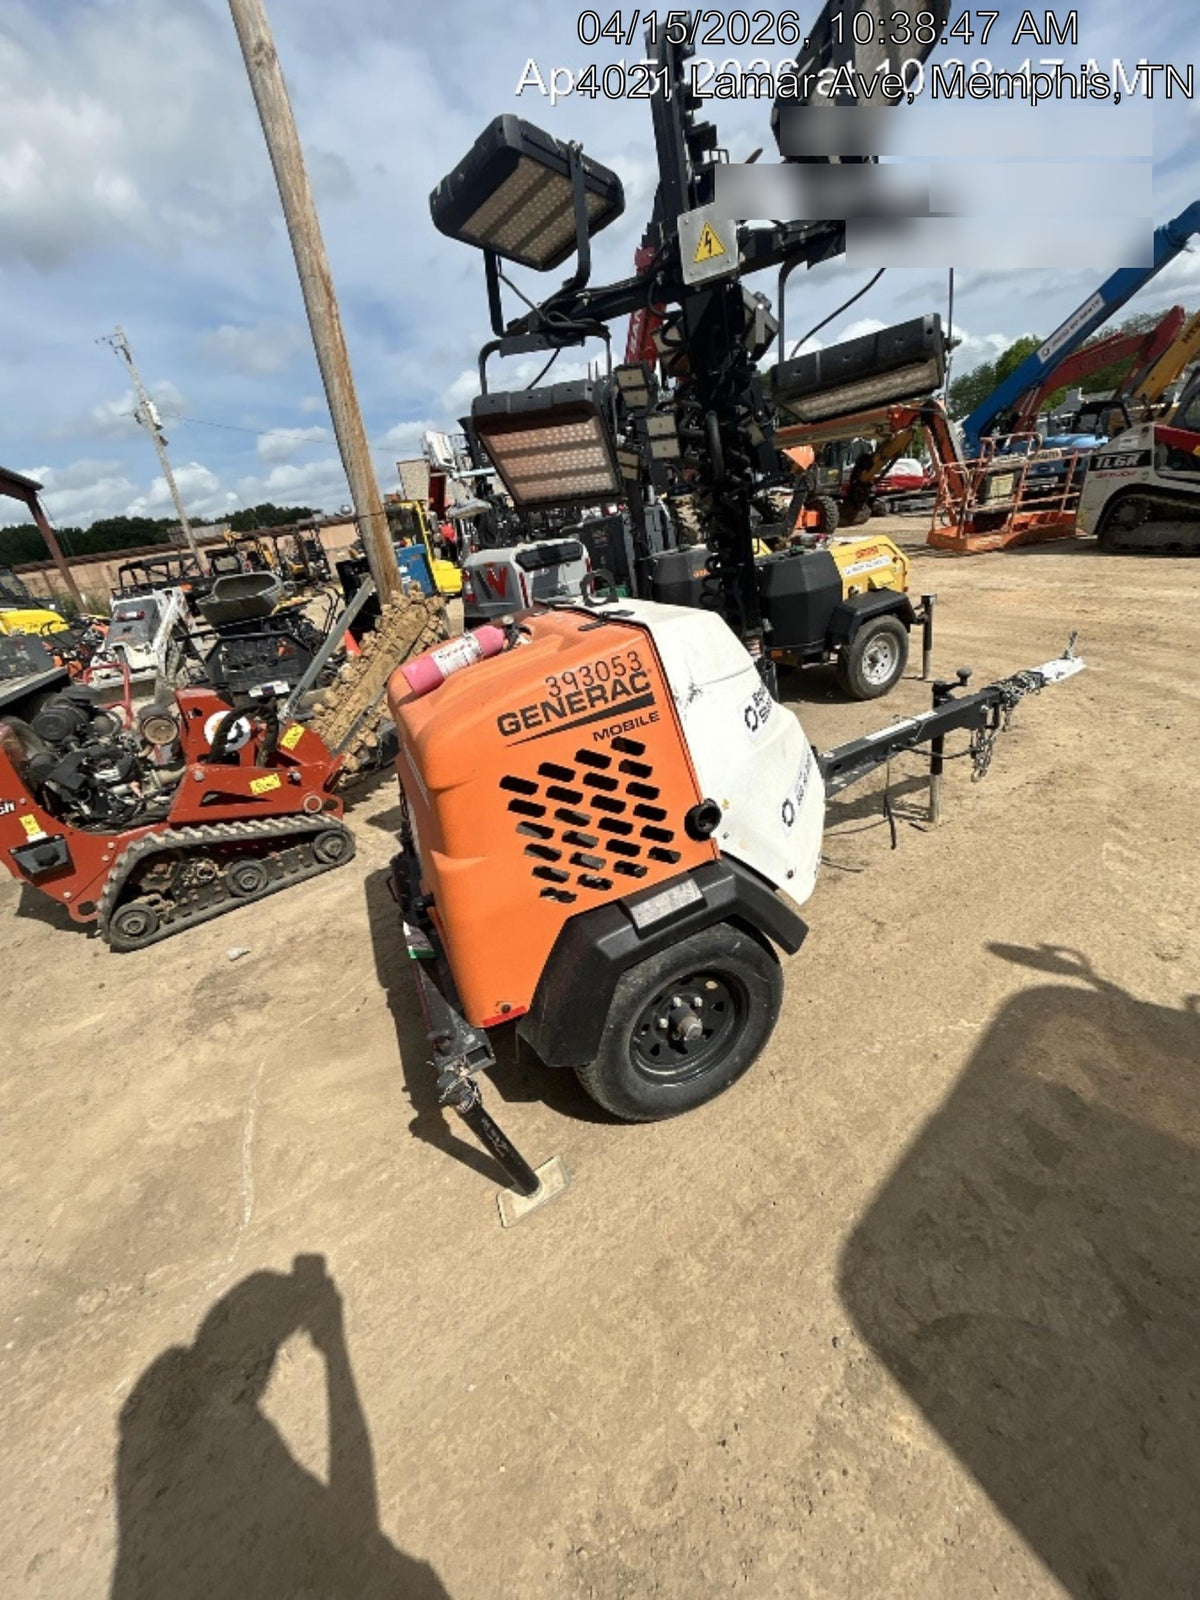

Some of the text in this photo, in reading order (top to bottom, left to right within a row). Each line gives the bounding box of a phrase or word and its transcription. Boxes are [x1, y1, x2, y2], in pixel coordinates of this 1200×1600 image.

[545, 650, 642, 697] 393053
[497, 671, 651, 736] GENERAC
[593, 711, 660, 741] MOBILE
